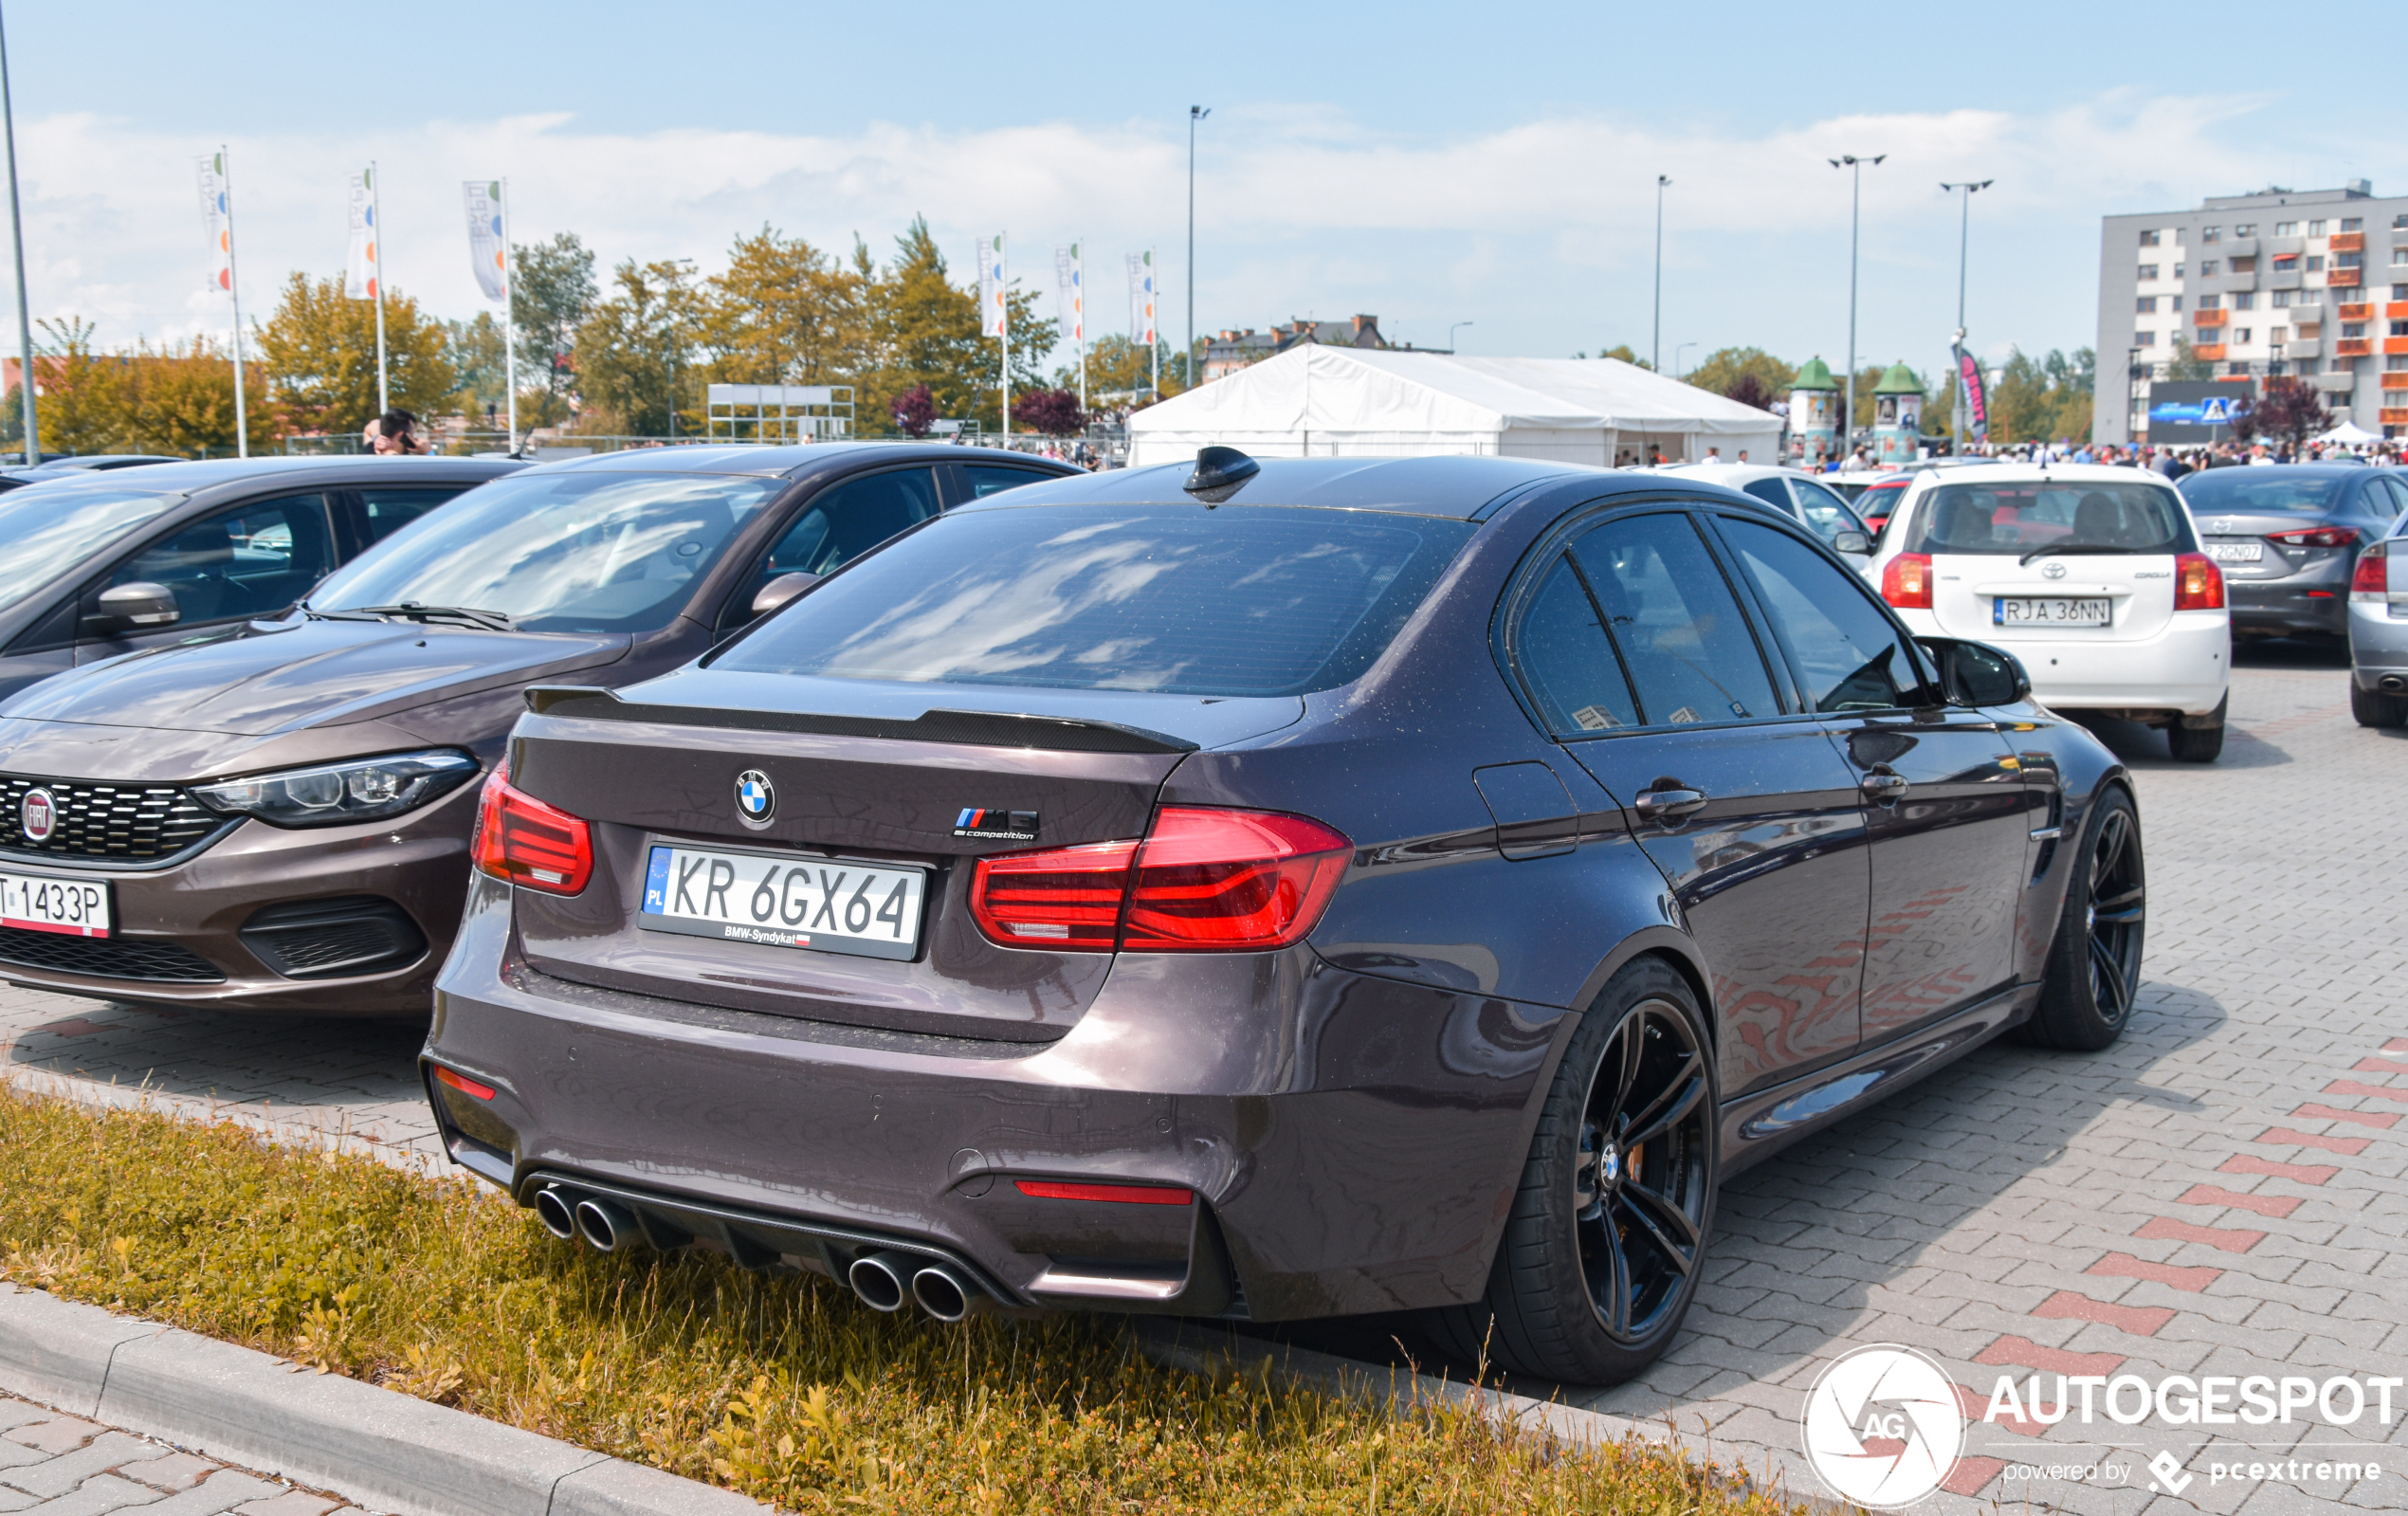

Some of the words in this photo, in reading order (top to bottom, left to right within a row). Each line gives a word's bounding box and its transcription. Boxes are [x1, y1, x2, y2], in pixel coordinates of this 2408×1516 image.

[2007, 602, 2049, 620] RJA
[2056, 602, 2107, 620] 36NN
[737, 771, 771, 791] BMW
[27, 804, 48, 829] FIAT
[966, 830, 1034, 841] competition
[21, 881, 99, 924] 1433P
[647, 888, 664, 907] PL
[673, 855, 736, 919] KR
[750, 864, 908, 940] 6GX64
[724, 925, 796, 945] BMW-Syndykat
